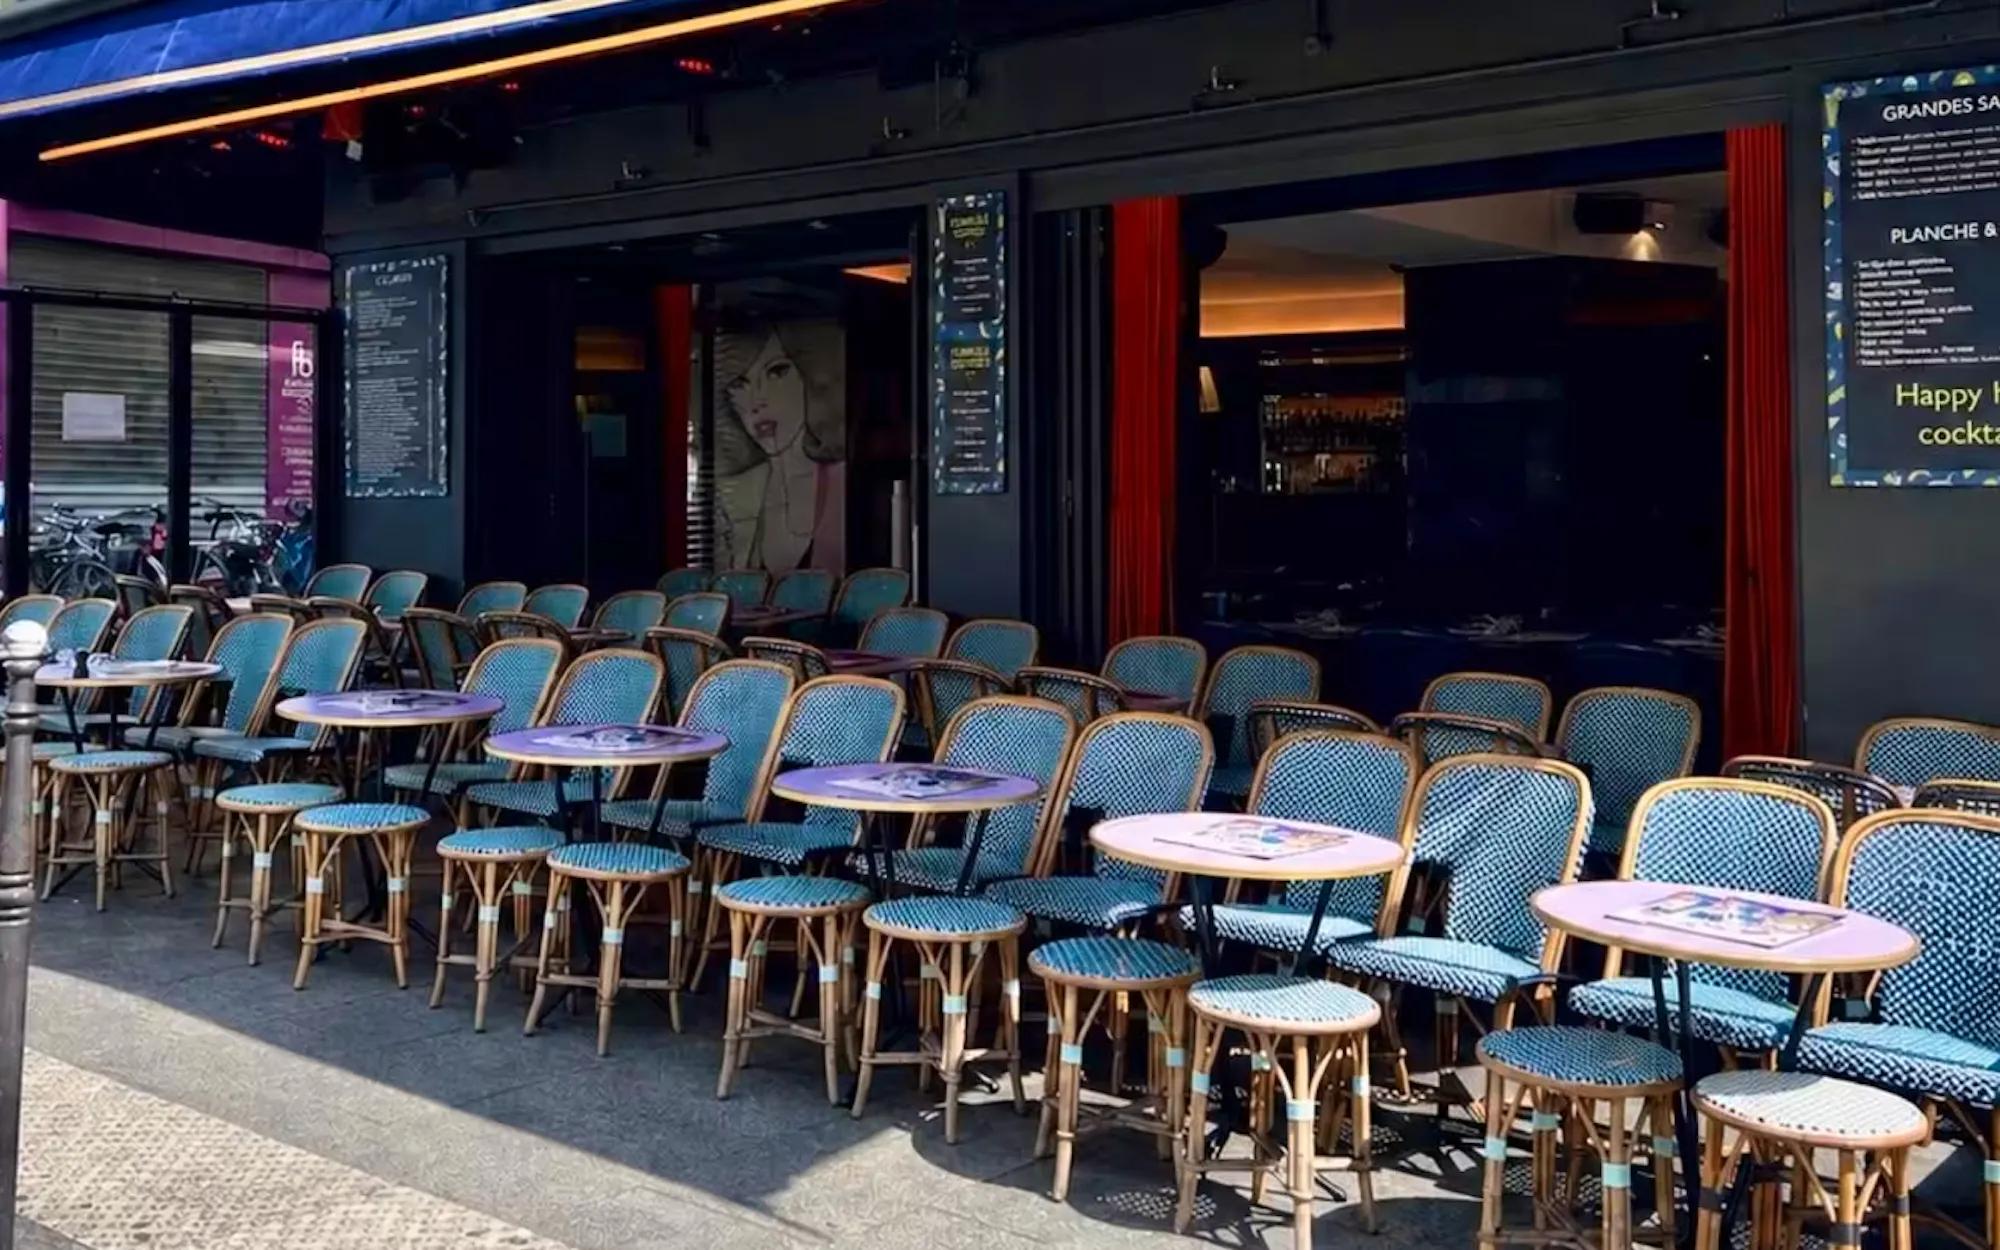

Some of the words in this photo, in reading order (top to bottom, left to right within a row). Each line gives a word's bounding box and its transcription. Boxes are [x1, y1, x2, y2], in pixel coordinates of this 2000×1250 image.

[1882, 96, 1974, 122] GRANDES
[1890, 222, 1979, 244] PLANCHE
[1983, 221, 1998, 238] &
[1896, 383, 1983, 413] Happy
